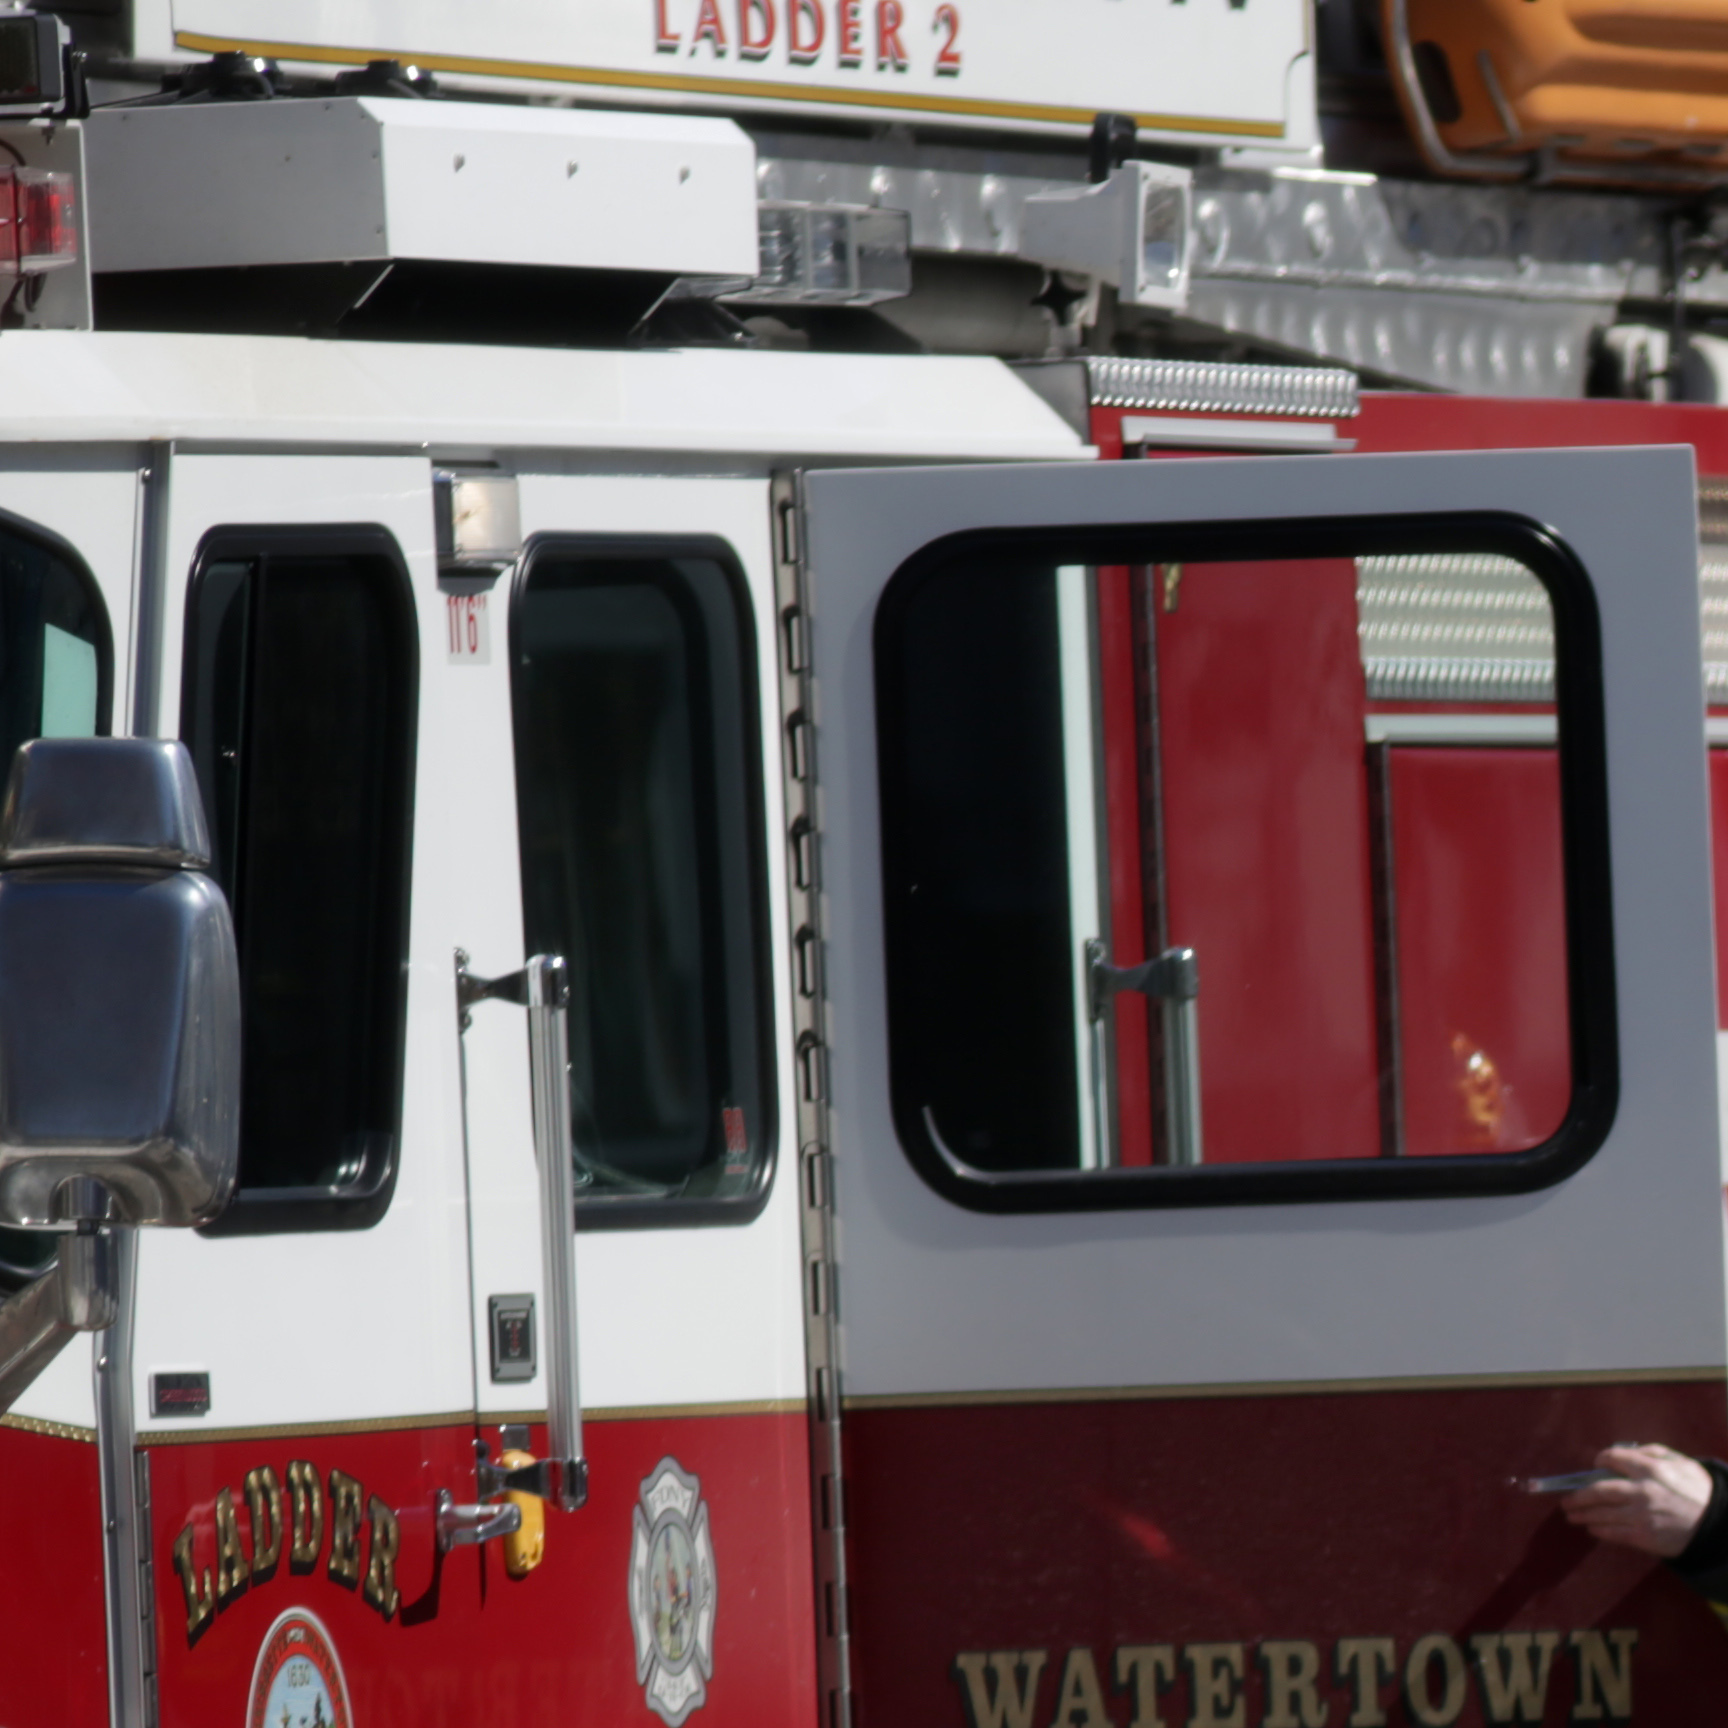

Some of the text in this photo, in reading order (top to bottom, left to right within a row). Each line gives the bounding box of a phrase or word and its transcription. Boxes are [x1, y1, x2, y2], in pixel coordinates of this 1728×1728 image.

[654, 0, 961, 77] LADDER 2
[173, 1459, 401, 1645] LADDER
